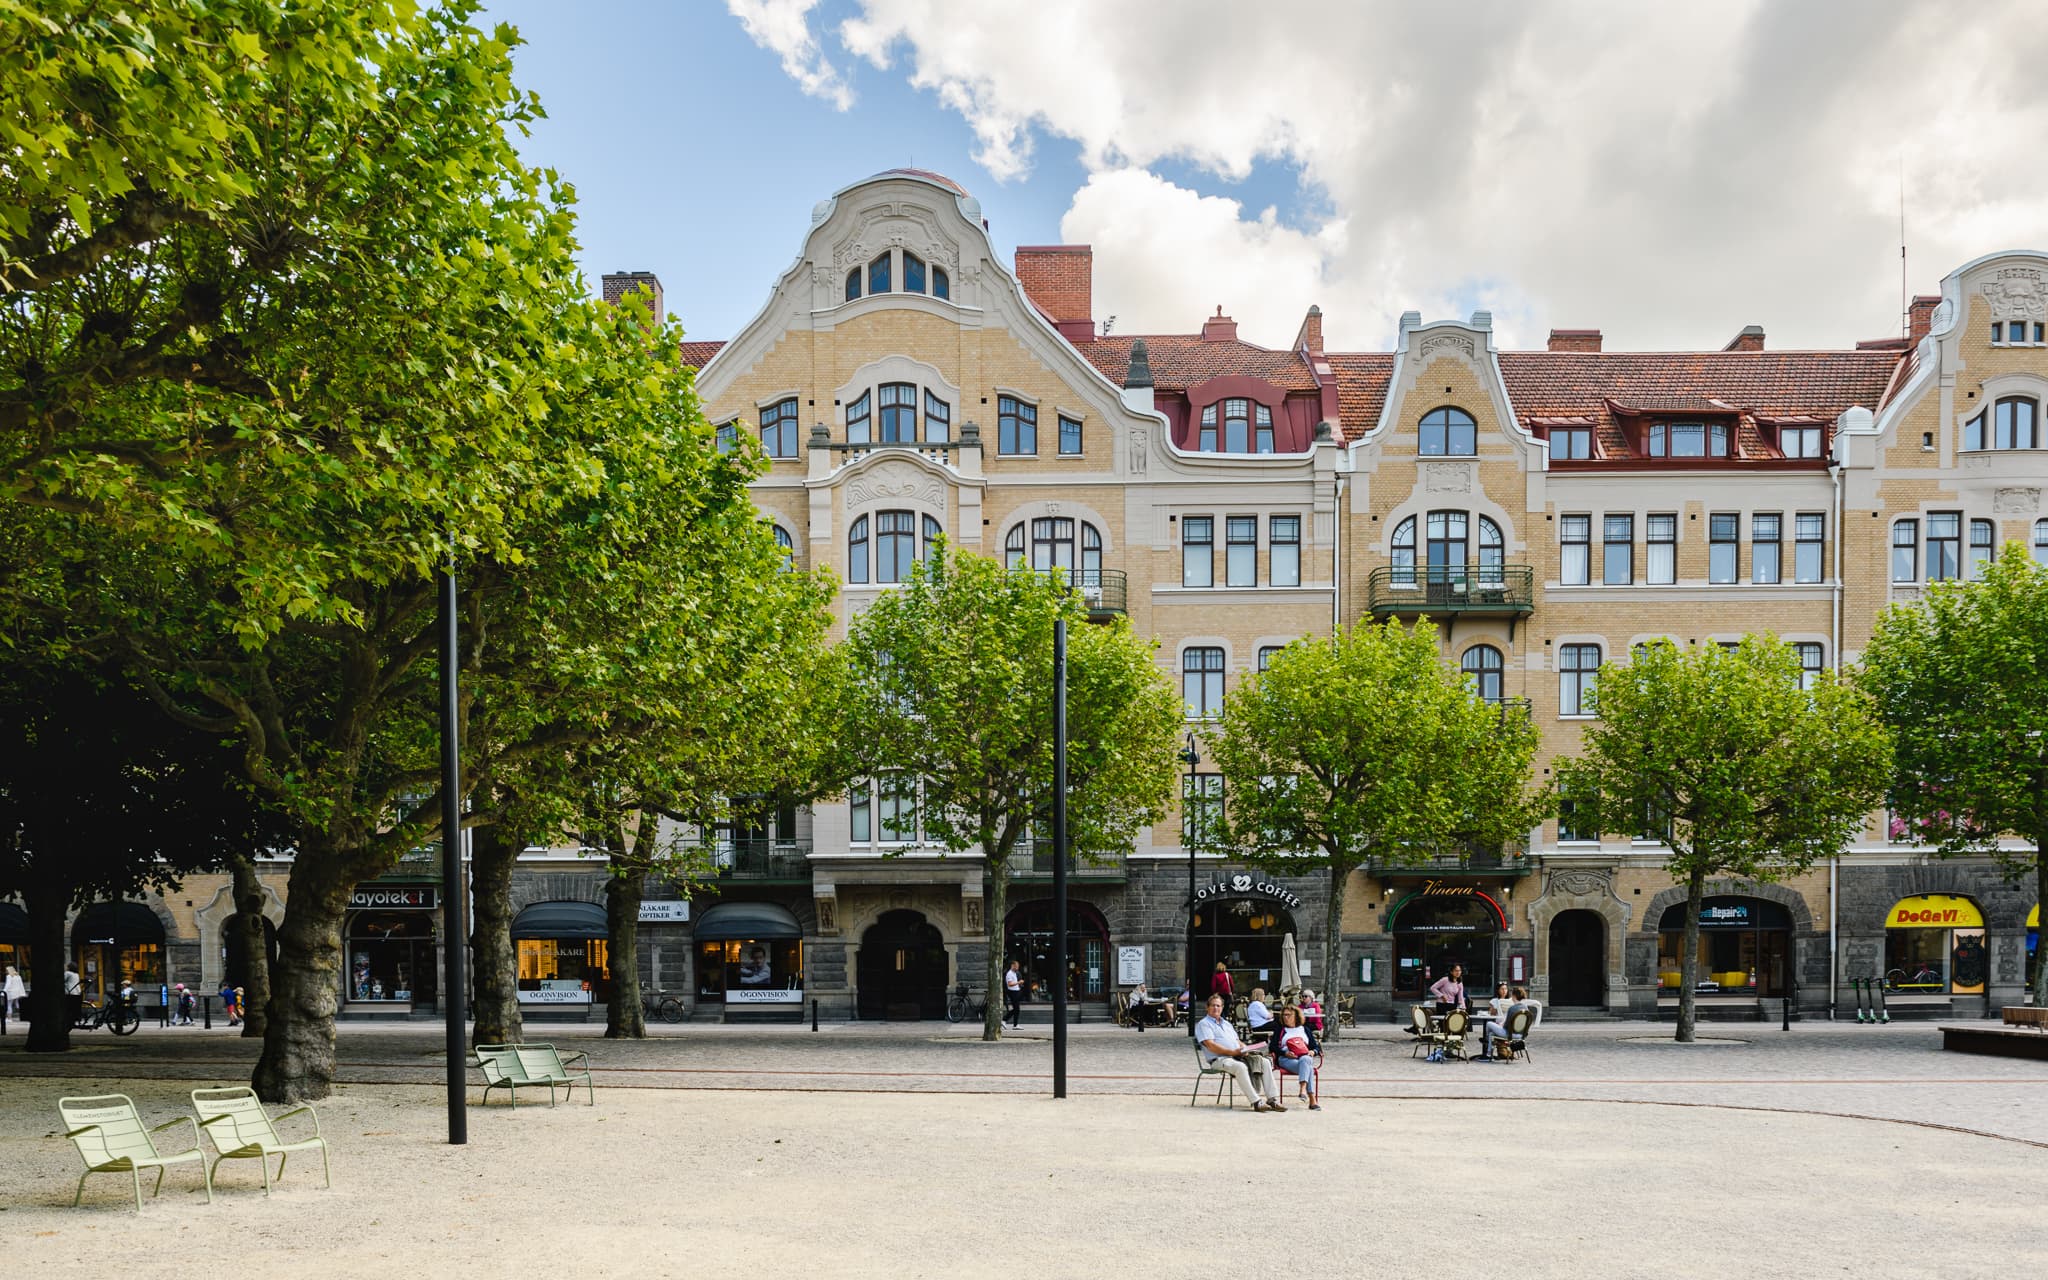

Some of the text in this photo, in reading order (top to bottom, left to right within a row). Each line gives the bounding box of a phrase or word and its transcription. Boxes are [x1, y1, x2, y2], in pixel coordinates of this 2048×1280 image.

[1256, 881, 1300, 907] COFFEE
[1423, 879, 1473, 896] Vineria
[351, 890, 424, 907] layoteket
